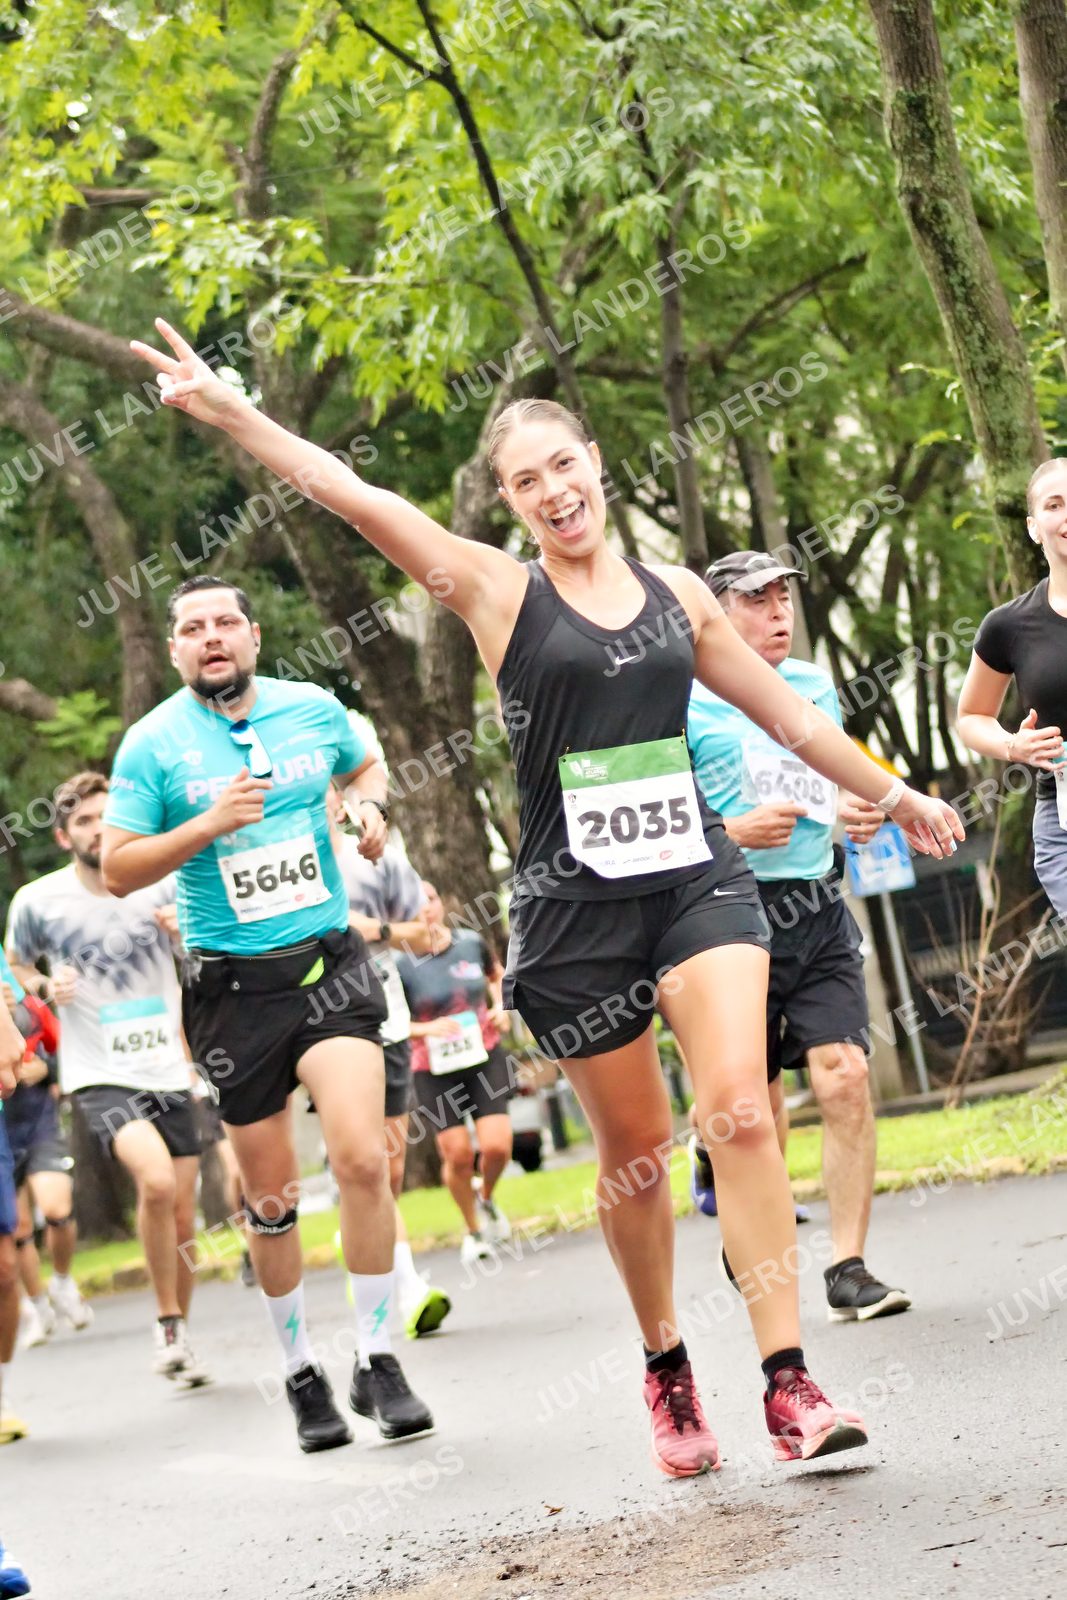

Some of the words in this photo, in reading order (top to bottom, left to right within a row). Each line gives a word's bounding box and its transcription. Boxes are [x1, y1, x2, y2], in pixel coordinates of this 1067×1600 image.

[186, 750, 329, 805] PEURA
[577, 796, 692, 849] 2035
[233, 853, 318, 899] 5646
[112, 1028, 168, 1053] 4924
